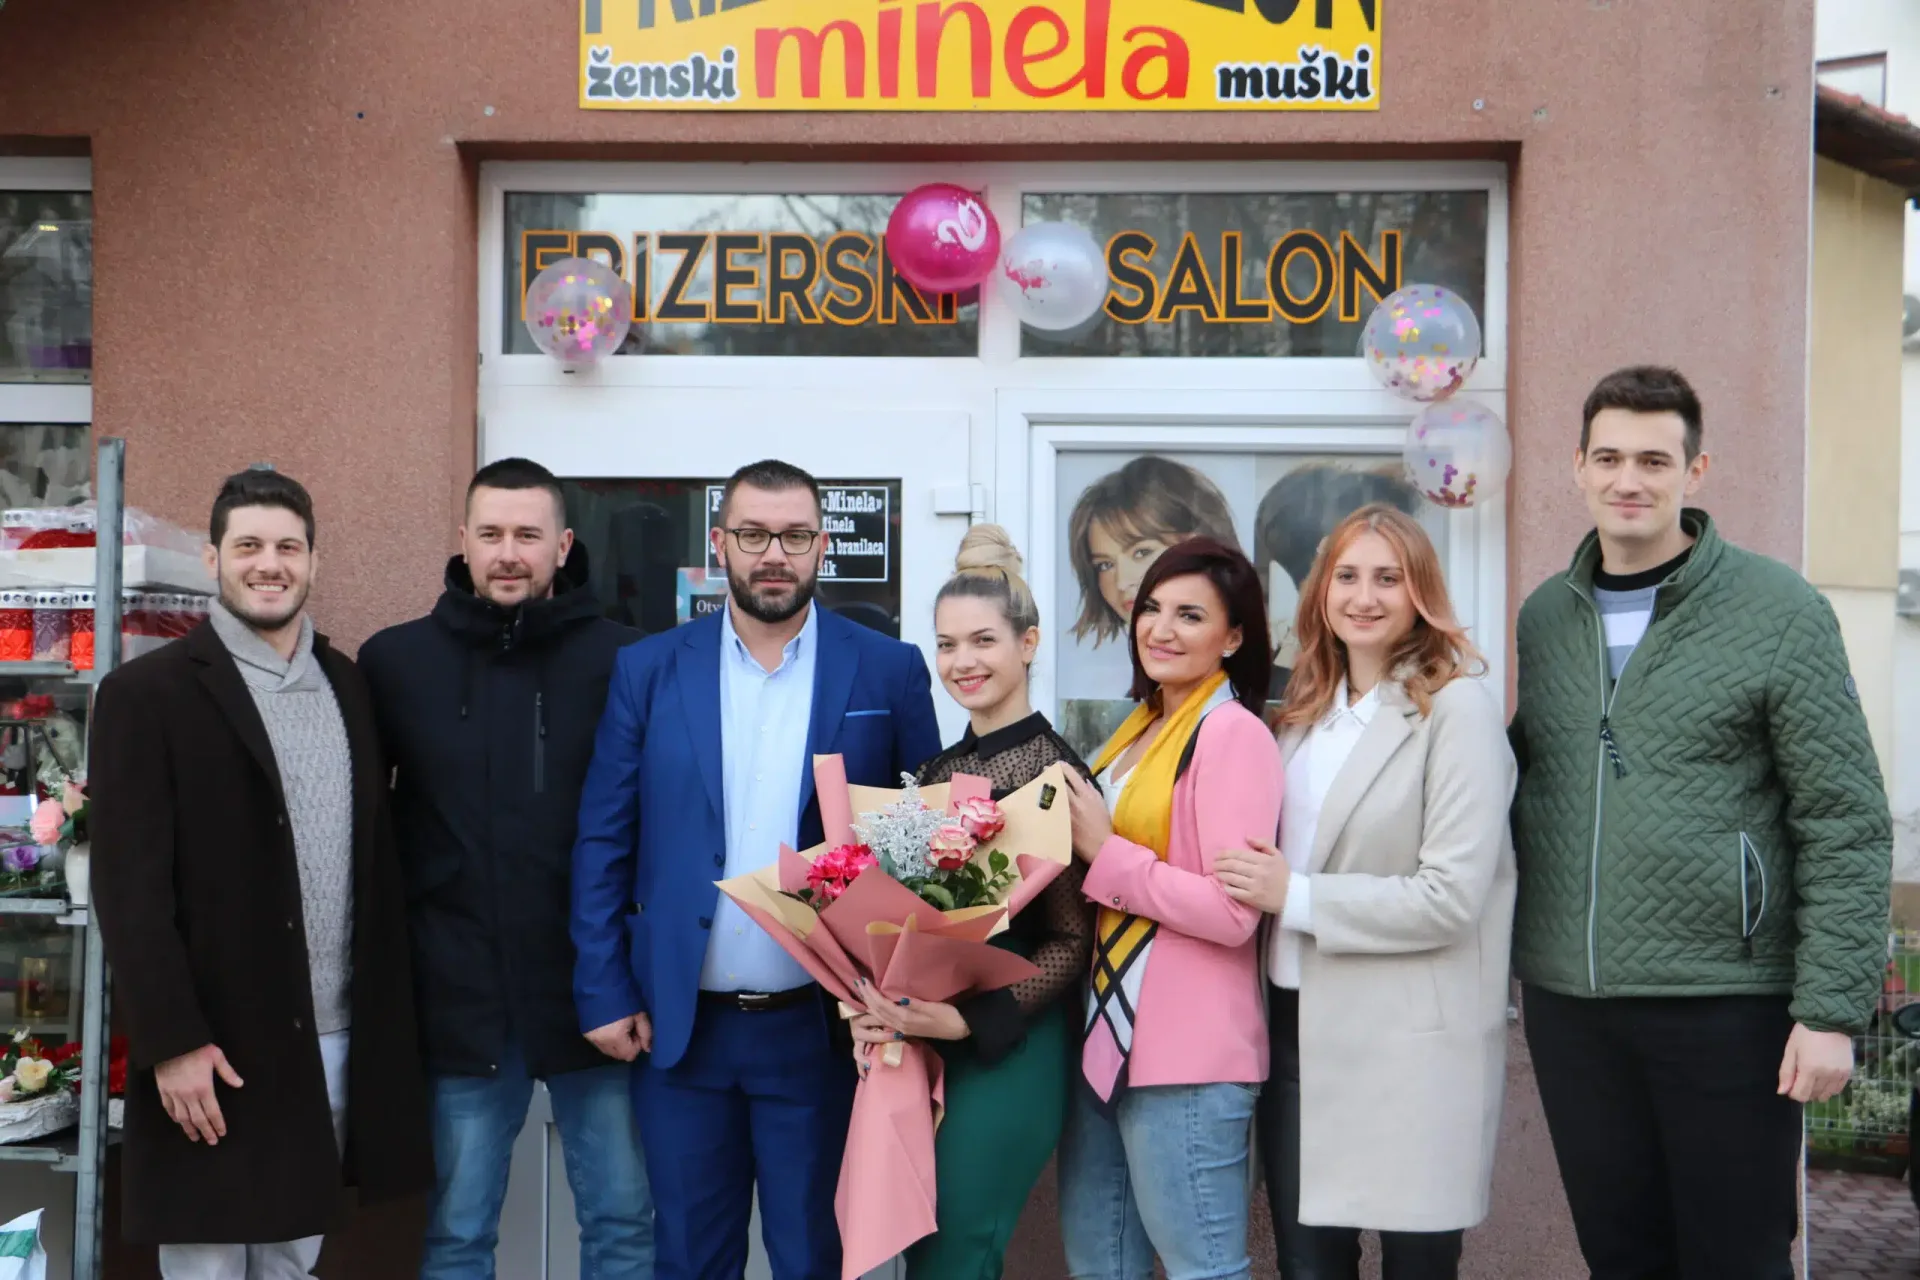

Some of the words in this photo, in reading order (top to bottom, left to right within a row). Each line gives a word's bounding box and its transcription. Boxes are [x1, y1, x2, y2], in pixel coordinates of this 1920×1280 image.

[587, 48, 737, 99] ženski
[754, 0, 1190, 100] minela
[1218, 48, 1371, 100] muški
[1103, 229, 1402, 324] SALON
[836, 537, 884, 556] branilaca
